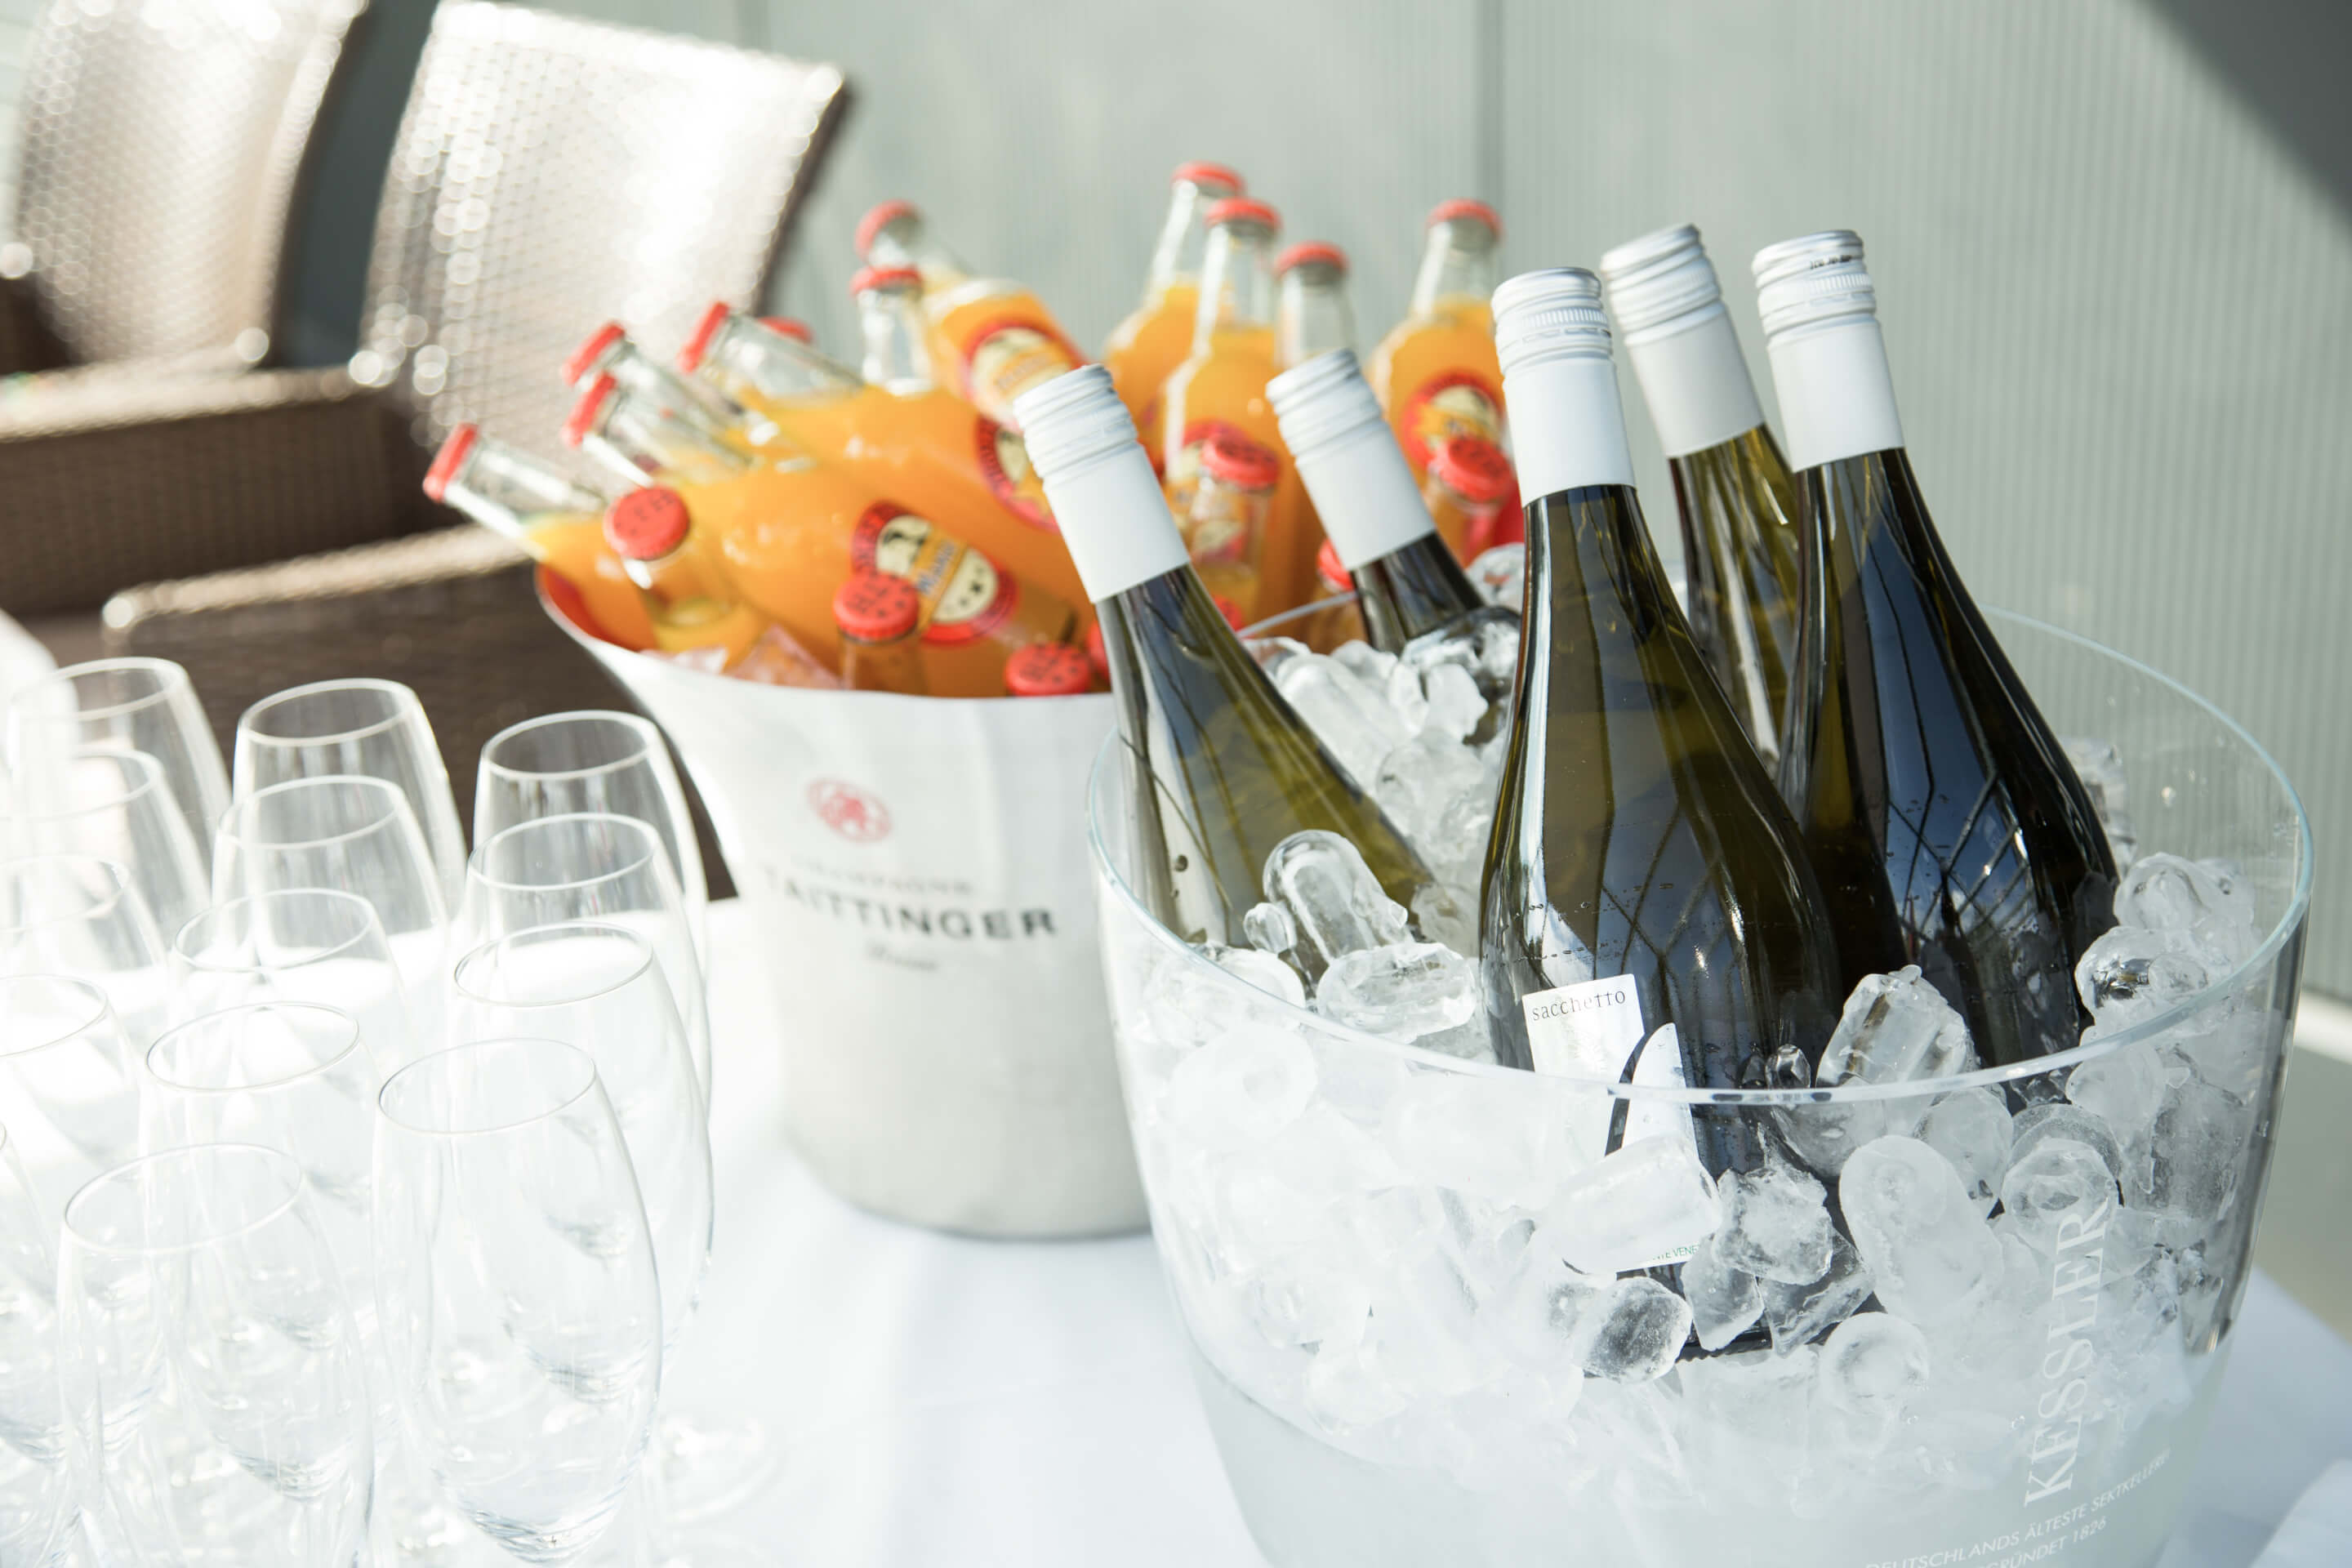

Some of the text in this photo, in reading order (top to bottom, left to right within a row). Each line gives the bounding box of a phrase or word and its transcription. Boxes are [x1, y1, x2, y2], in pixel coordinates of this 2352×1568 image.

[1532, 991, 1626, 1021] sacchetto
[1672, 1244, 1700, 1258] VENE
[2024, 1196, 2109, 1508] KESSLER
[2025, 1503, 2087, 1541] ÄLTESTE
[2073, 1516, 2107, 1543] 1826
